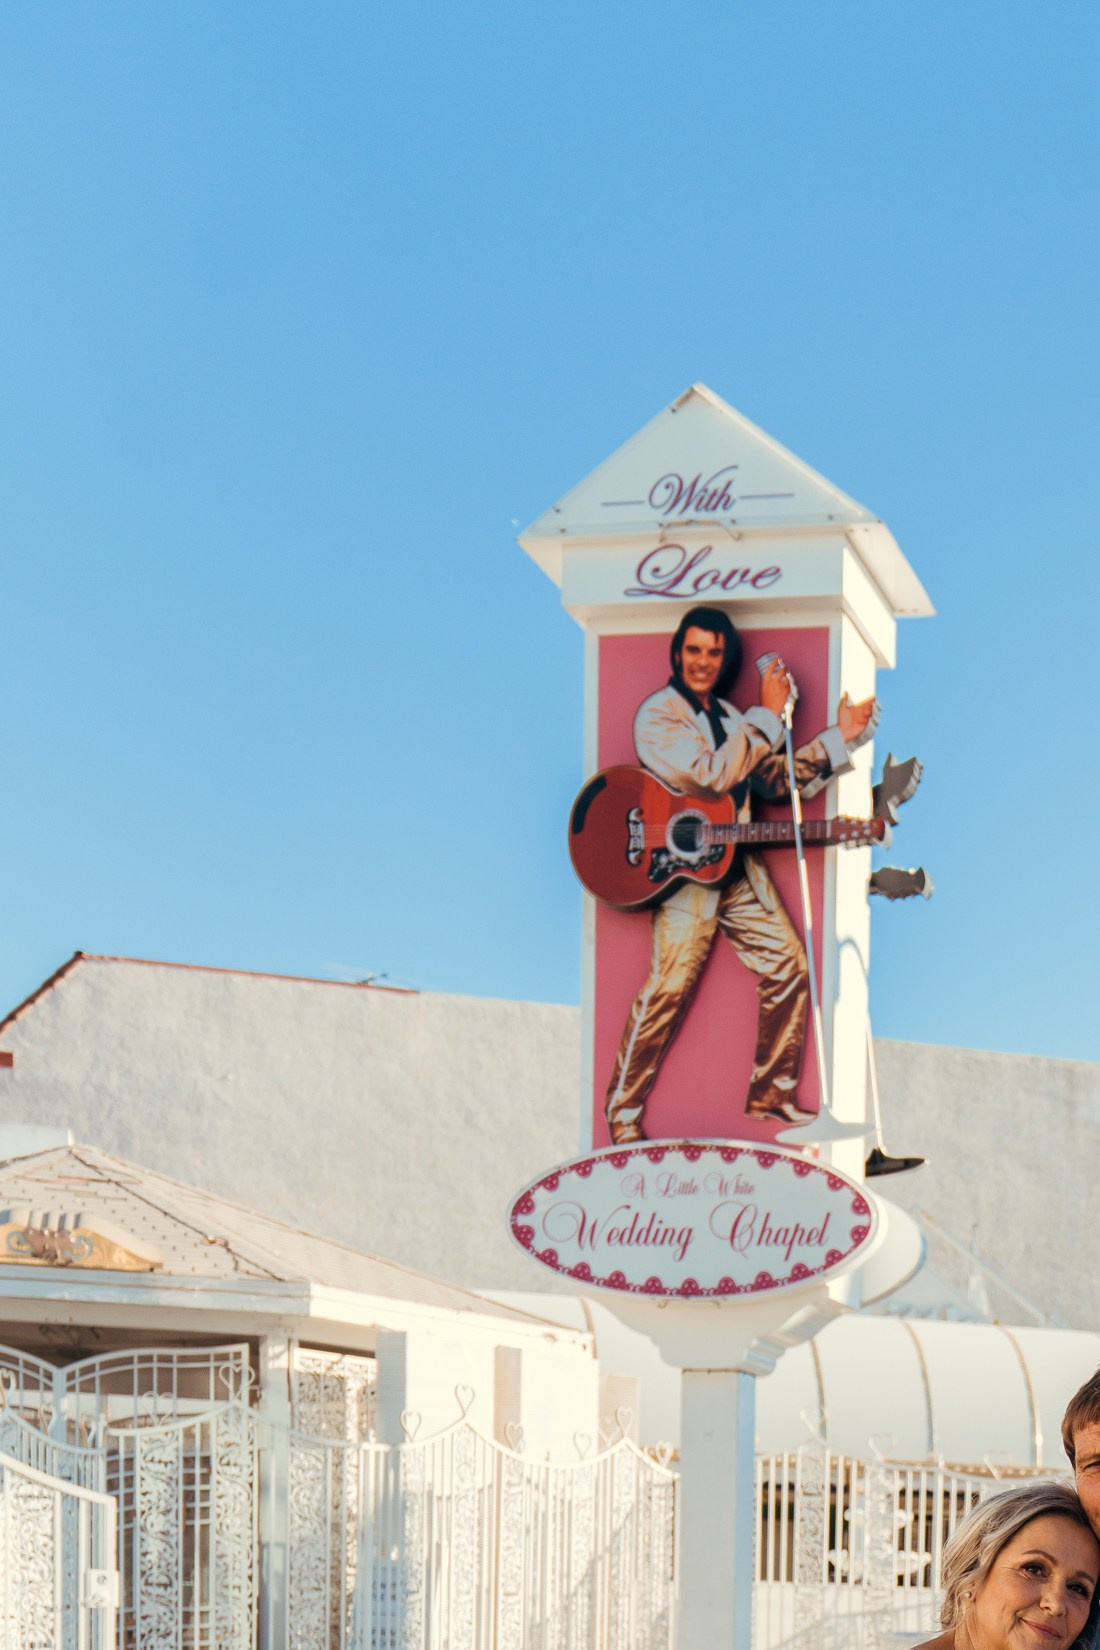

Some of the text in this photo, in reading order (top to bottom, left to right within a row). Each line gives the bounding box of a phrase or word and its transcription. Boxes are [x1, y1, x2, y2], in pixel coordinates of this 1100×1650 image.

[648, 465, 738, 516] With
[623, 543, 783, 598] Love
[620, 1171, 755, 1199] A Little White
[542, 1200, 831, 1263] Wedding Chapel
